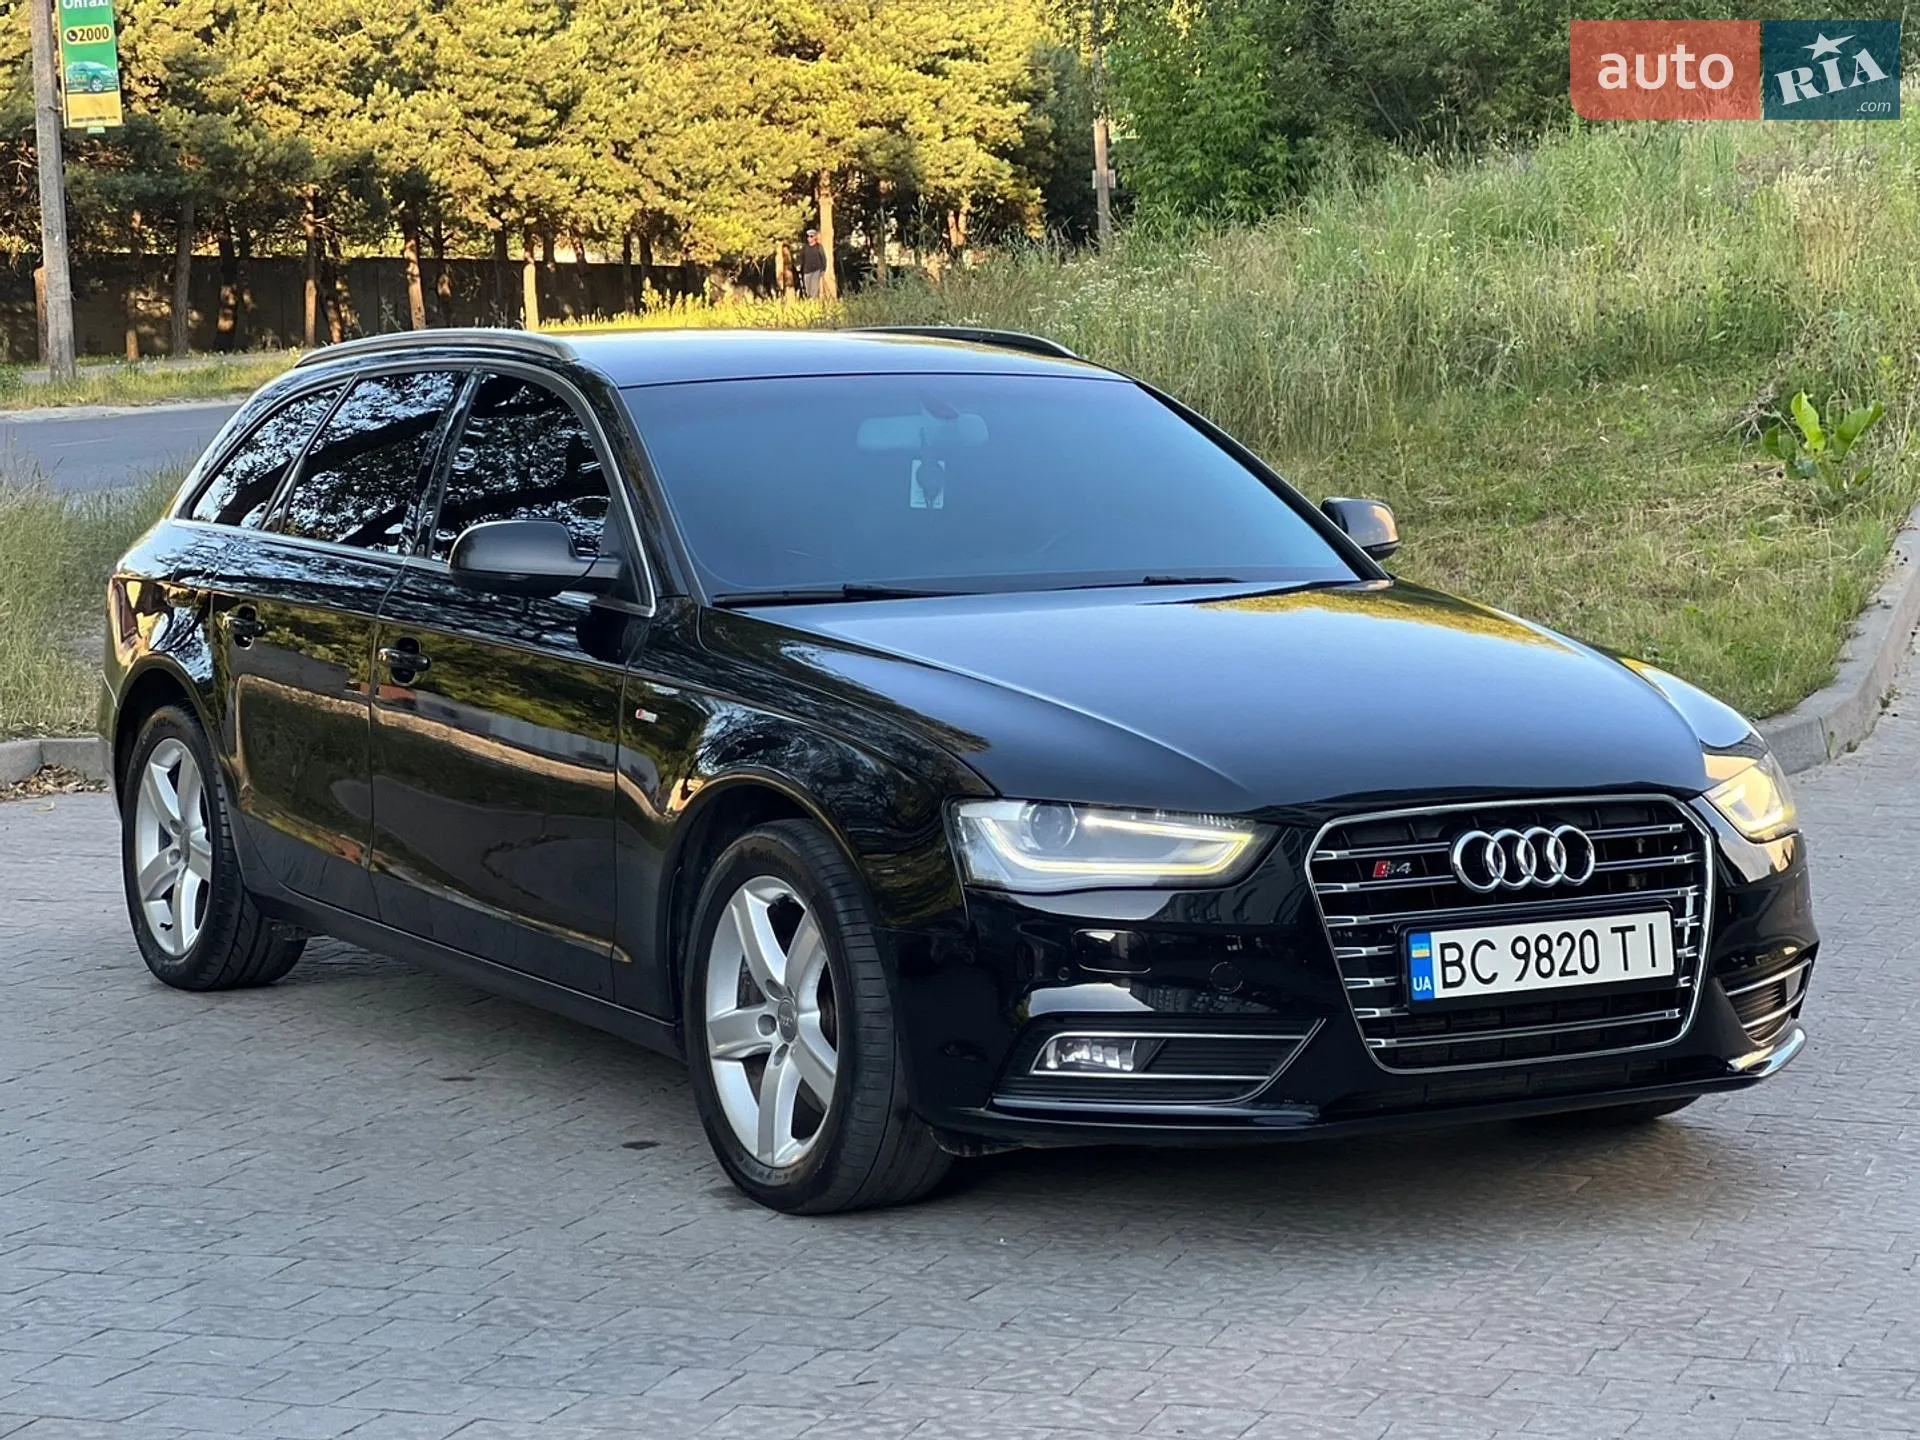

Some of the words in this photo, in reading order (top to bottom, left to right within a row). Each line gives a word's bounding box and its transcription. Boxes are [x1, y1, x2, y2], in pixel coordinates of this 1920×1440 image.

[78, 26, 109, 41] 2000
[1439, 938, 1498, 989] BC
[1510, 929, 1600, 982] 9820
[1611, 923, 1657, 971] TI
[1413, 976, 1433, 992] UA
